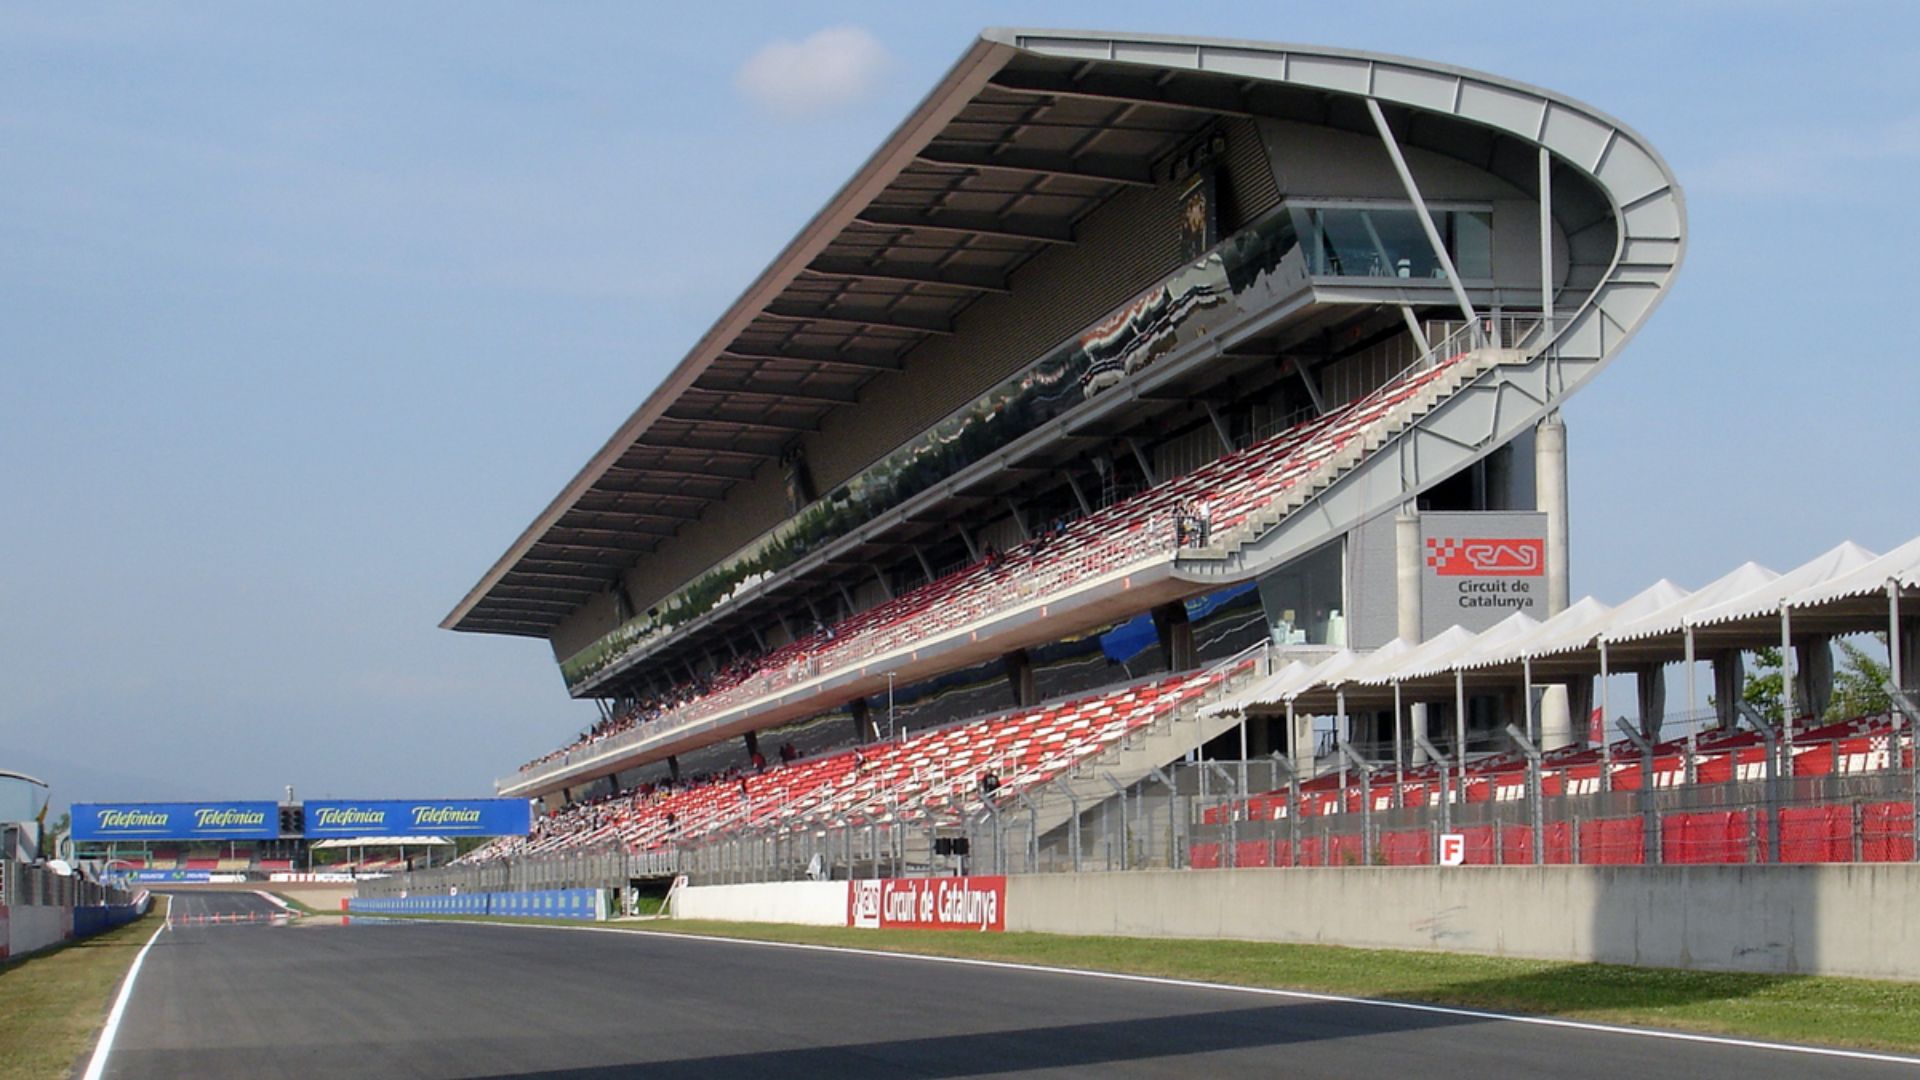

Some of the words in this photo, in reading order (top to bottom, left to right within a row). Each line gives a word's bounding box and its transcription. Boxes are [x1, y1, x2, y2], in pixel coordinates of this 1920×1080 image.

[1458, 580, 1506, 593] Circuit
[1511, 580, 1530, 593] de
[1458, 595, 1534, 610] Catalunya
[1444, 839, 1460, 861] F
[883, 880, 917, 922] Circuit
[919, 879, 934, 923] de
[938, 878, 998, 932] Catalunya
